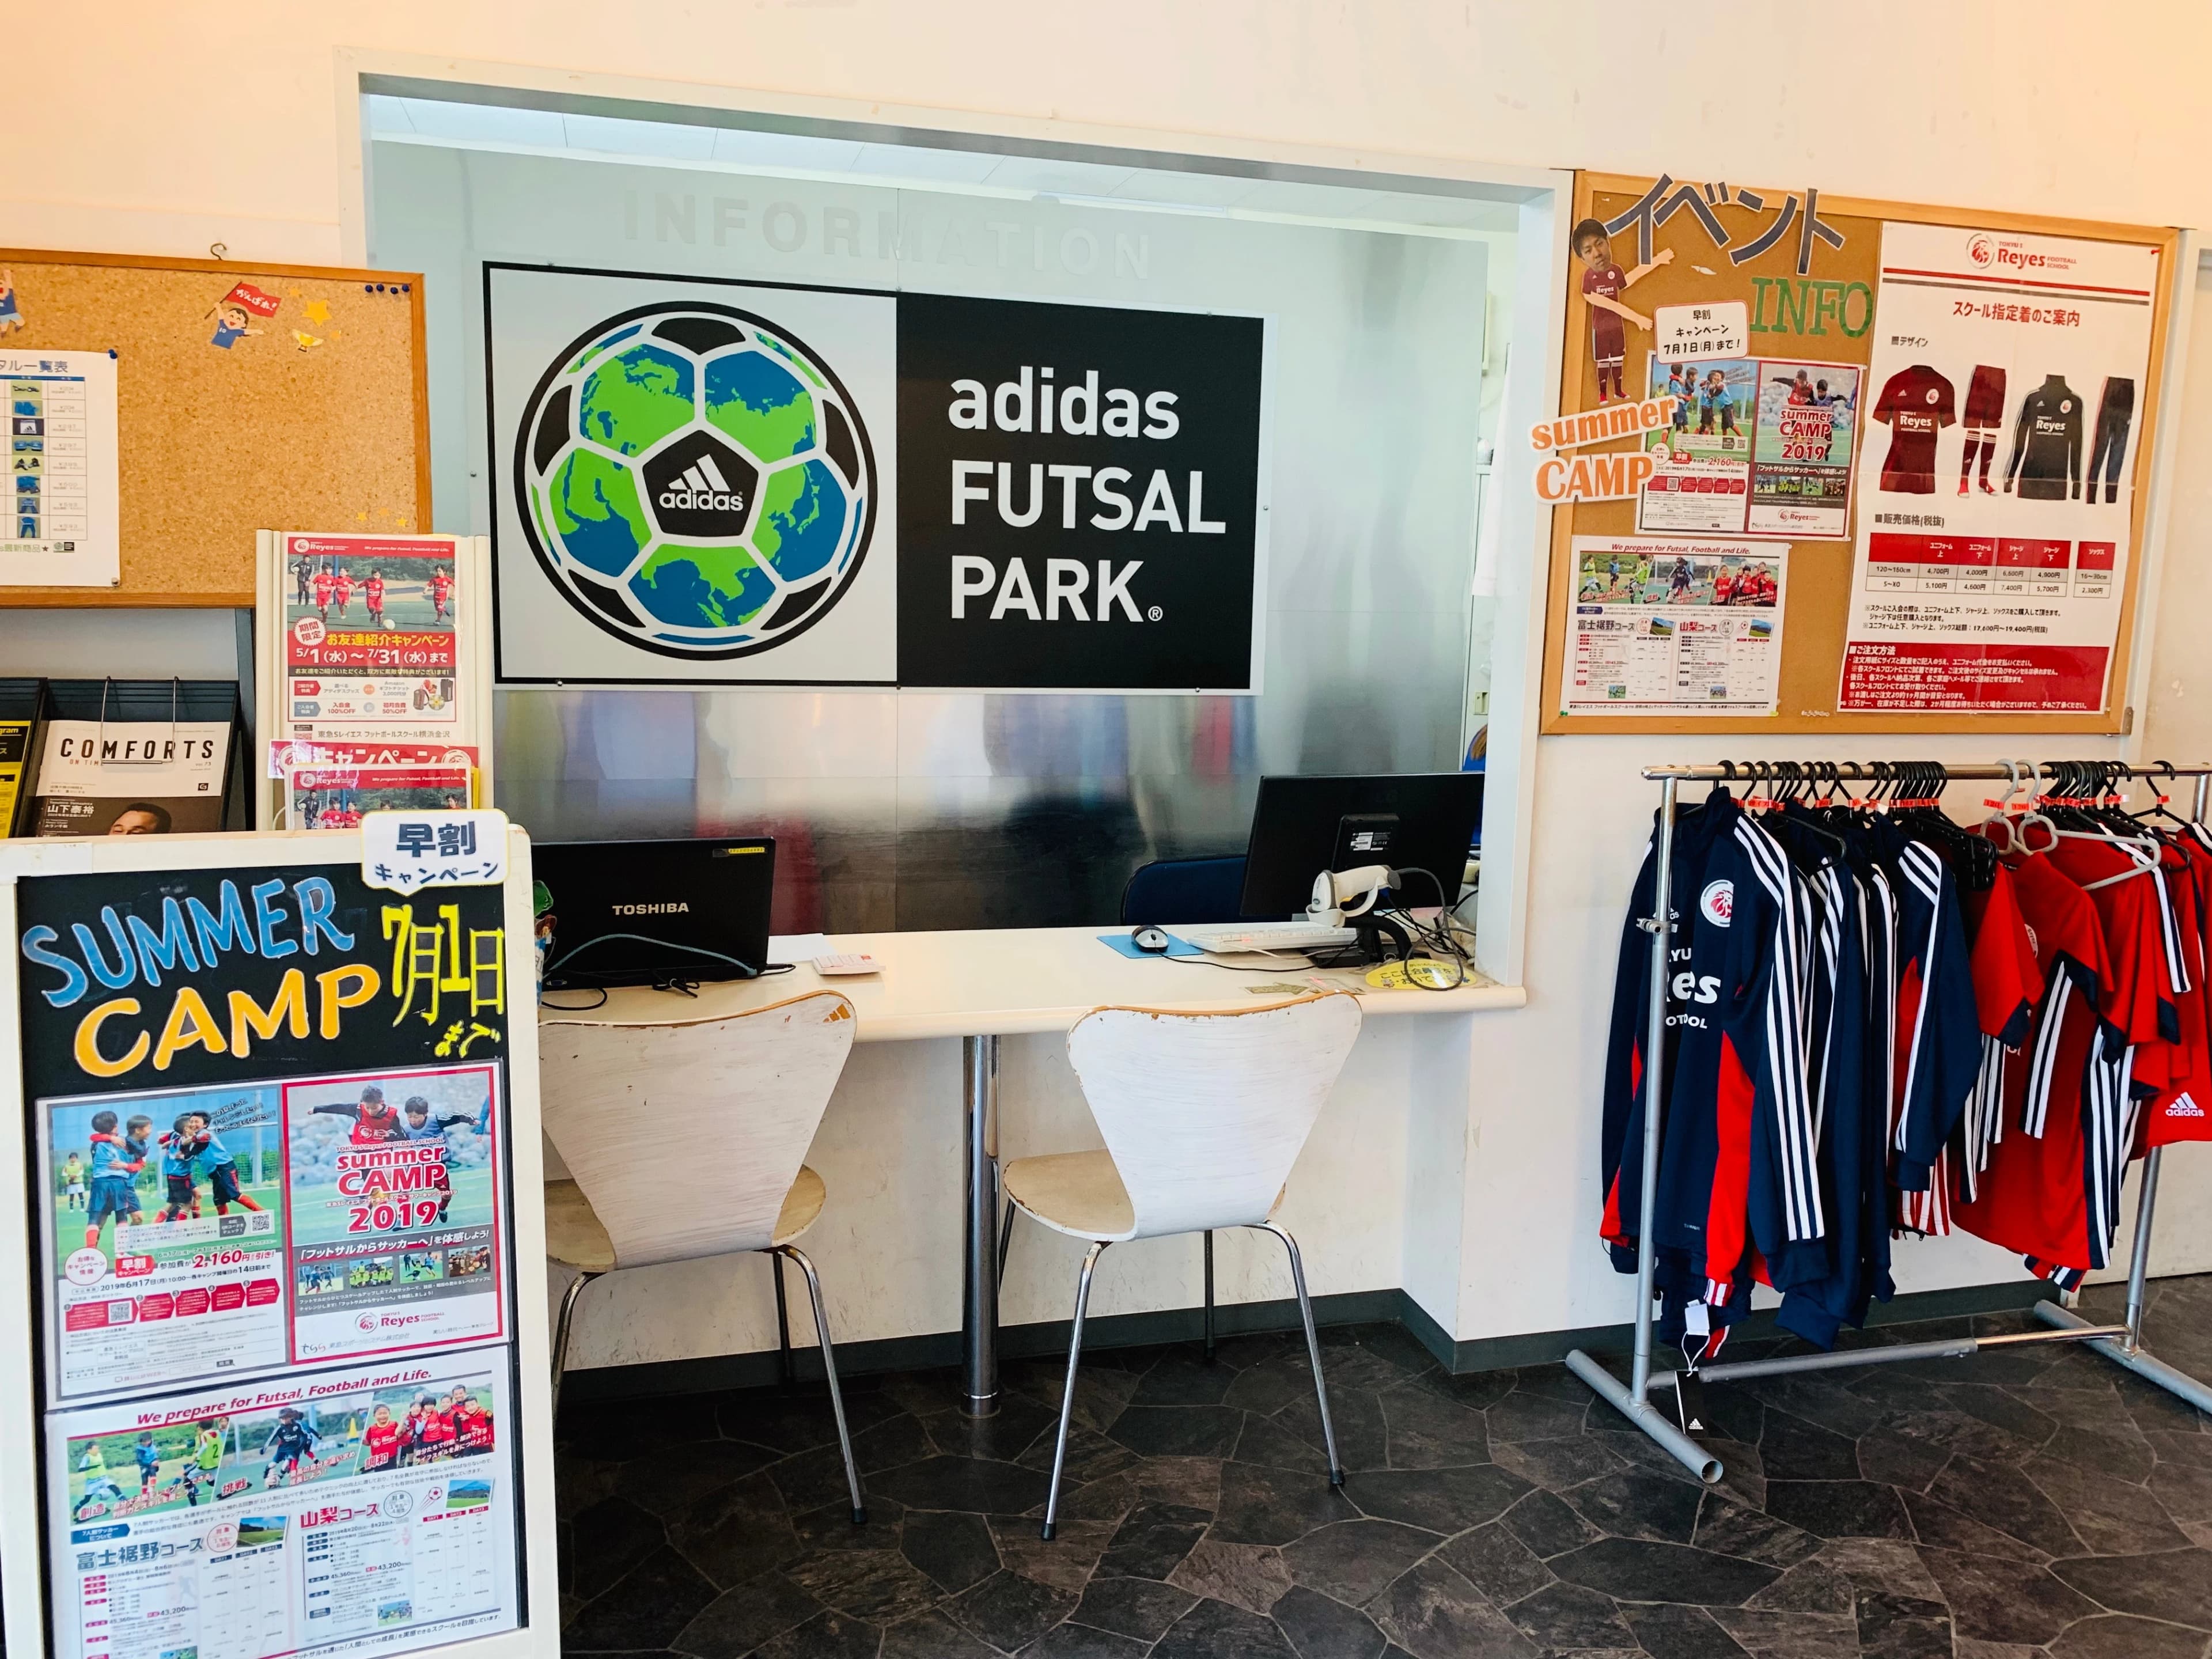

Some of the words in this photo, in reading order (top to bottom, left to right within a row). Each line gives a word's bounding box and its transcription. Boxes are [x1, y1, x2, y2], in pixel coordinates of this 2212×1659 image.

[1604, 173, 1844, 275] イベント
[624, 189, 1150, 281] INFORMATION
[1998, 248, 2046, 270] Reyes
[2047, 256, 2077, 264] FOOTBALL
[1596, 286, 1614, 294] Reyes
[1693, 309, 1711, 320] 早割
[1749, 277, 1872, 338] INFO
[1953, 301, 2080, 328] スクール指定着のご案内
[1676, 325, 1729, 337] キャンペーン
[948, 366, 1180, 440] adidas
[1532, 399, 1675, 449] summer
[1781, 411, 1831, 421] summer
[1900, 415, 1932, 427] Reyes
[1779, 423, 1831, 437] CAMP
[2036, 420, 2066, 431] Reyes
[1782, 444, 1824, 460] 2019
[1536, 457, 1653, 499] CAMP
[660, 489, 743, 511] adidas
[952, 460, 1226, 533] FUTSAL
[310, 543, 334, 551] Reyes
[1624, 545, 1653, 553] prepare
[298, 622, 319, 631] 期間
[1680, 621, 1717, 632] 山梨コース
[301, 631, 321, 641] 限定
[327, 634, 449, 646] お友達紹介キャンペーン
[60, 738, 213, 759] COMFORTS
[316, 778, 341, 786] Reyes
[396, 823, 476, 858] 早割
[375, 862, 498, 884] キャンペーン
[612, 903, 690, 915] TOSHIBA
[22, 877, 355, 1009] SUMMER
[382, 904, 505, 1028] 7月1日
[73, 963, 382, 1078] CAMP
[435, 1021, 501, 1058] まで
[2165, 1108, 2205, 1117] adidas
[384, 1140, 417, 1148] FOOTBALL
[338, 1146, 444, 1170] summer
[339, 1164, 445, 1195] CAMP
[349, 1202, 439, 1232] 2019
[118, 1268, 150, 1277] キャンペーン
[122, 1259, 146, 1270] 早割
[381, 1315, 420, 1328] Reyes
[138, 1413, 161, 1425] We
[165, 1404, 226, 1424] prepare
[230, 1396, 251, 1410] for
[256, 1388, 304, 1405] Futsal,
[308, 1378, 368, 1397] Football
[372, 1375, 398, 1387] and
[403, 1370, 432, 1382] Life.
[213, 1444, 219, 1459] 2
[365, 1453, 388, 1469] 調和
[222, 1478, 248, 1495] 挑戦
[79, 1503, 106, 1521] 創造
[300, 1503, 380, 1529] 山梨コース
[77, 1537, 204, 1571] 富士裾野コース
